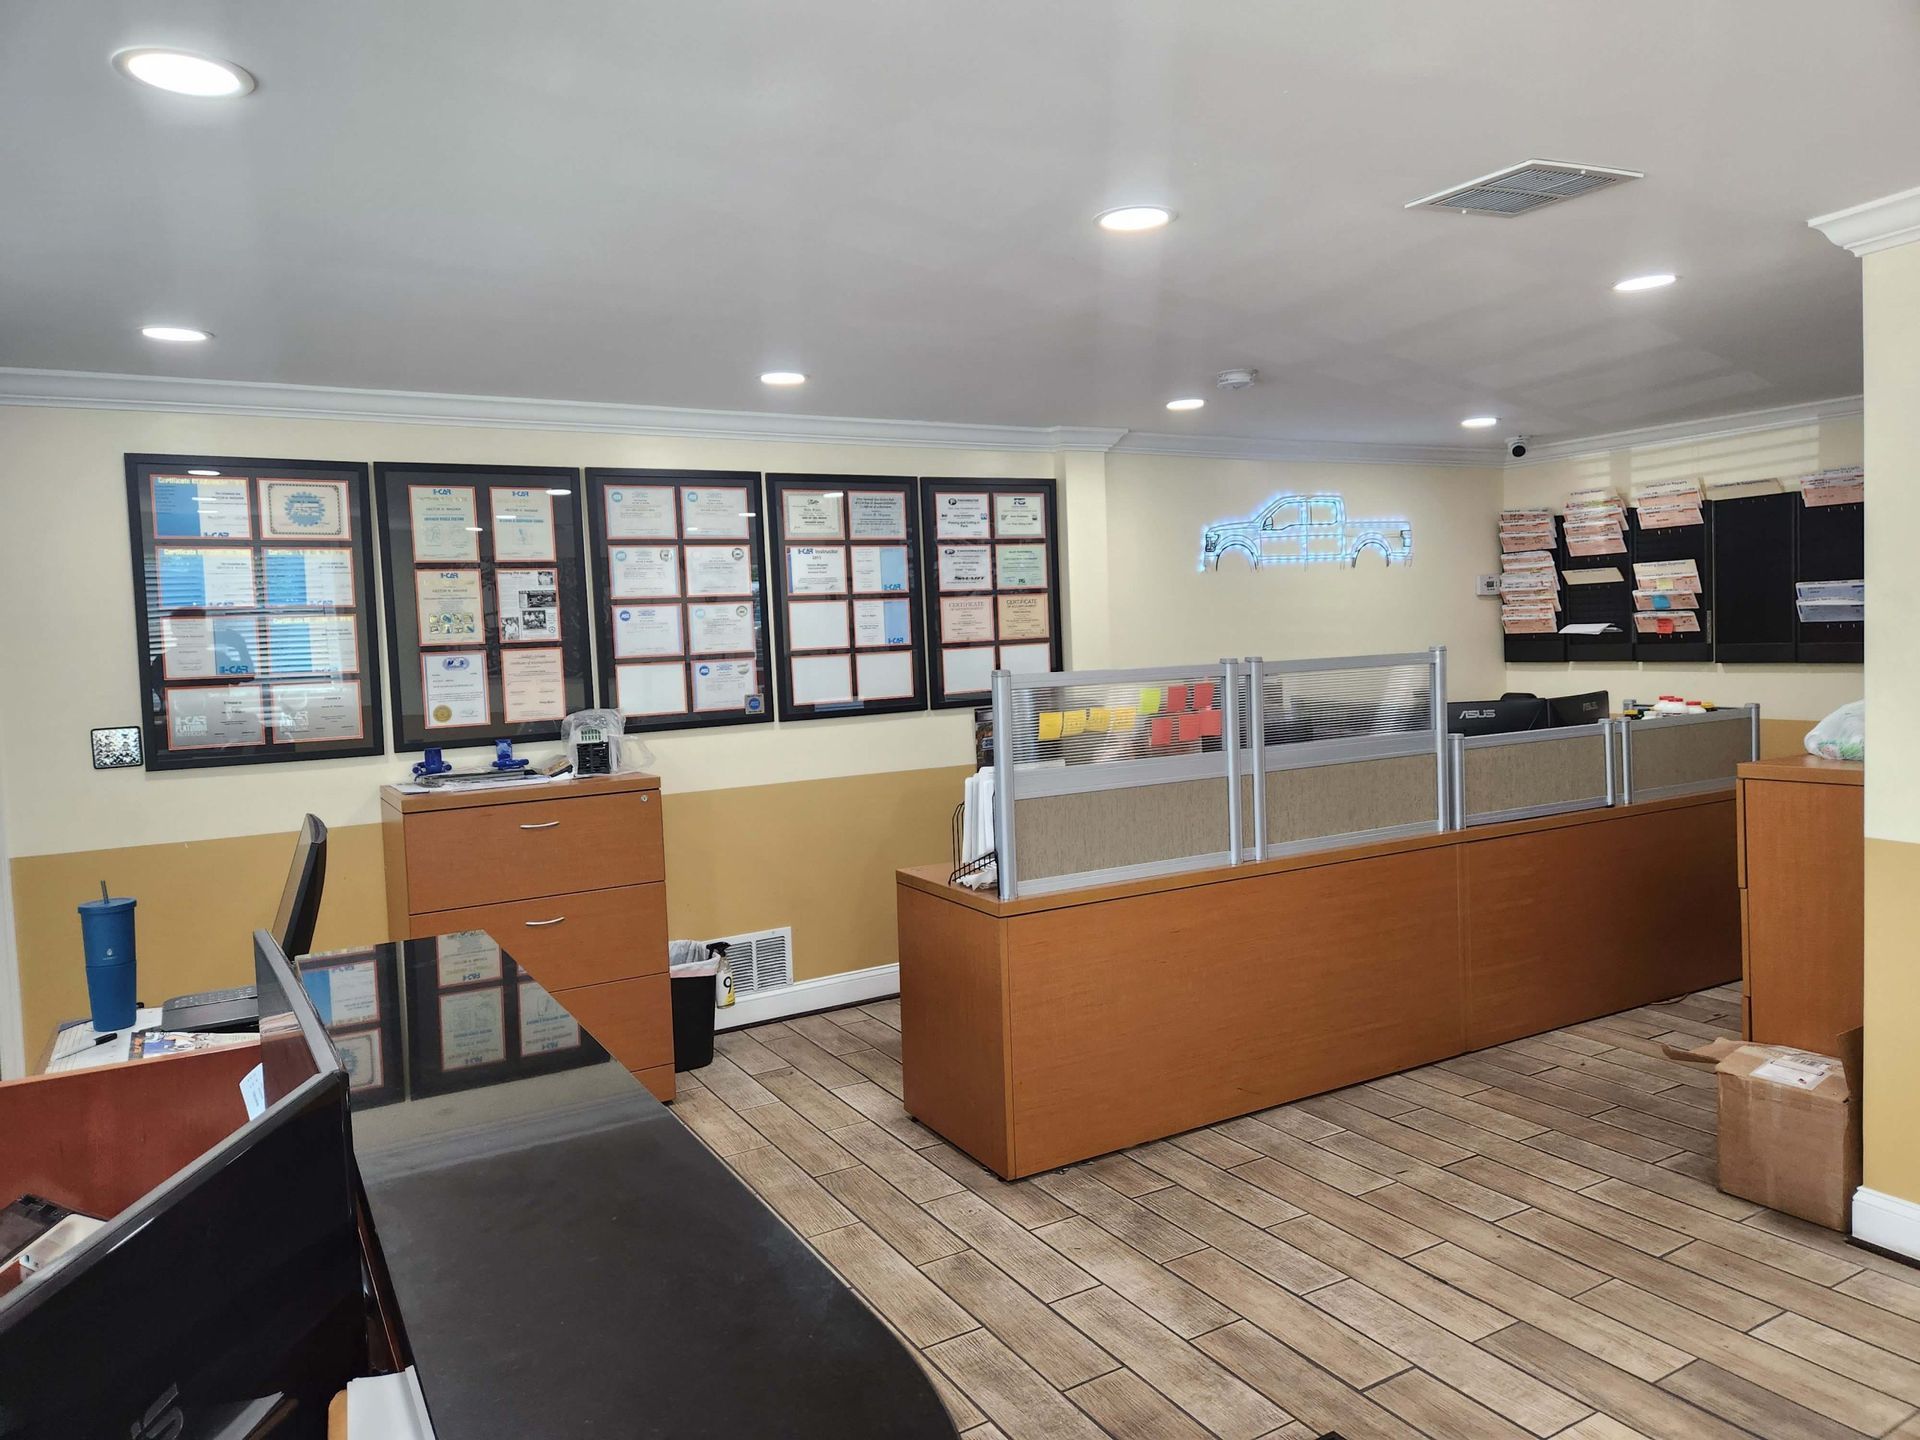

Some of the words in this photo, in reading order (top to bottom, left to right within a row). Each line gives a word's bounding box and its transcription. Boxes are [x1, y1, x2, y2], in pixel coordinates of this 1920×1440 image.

[219, 665, 248, 674] I-CAR
[1459, 709, 1496, 719] ASUS
[723, 976, 732, 994] 9
